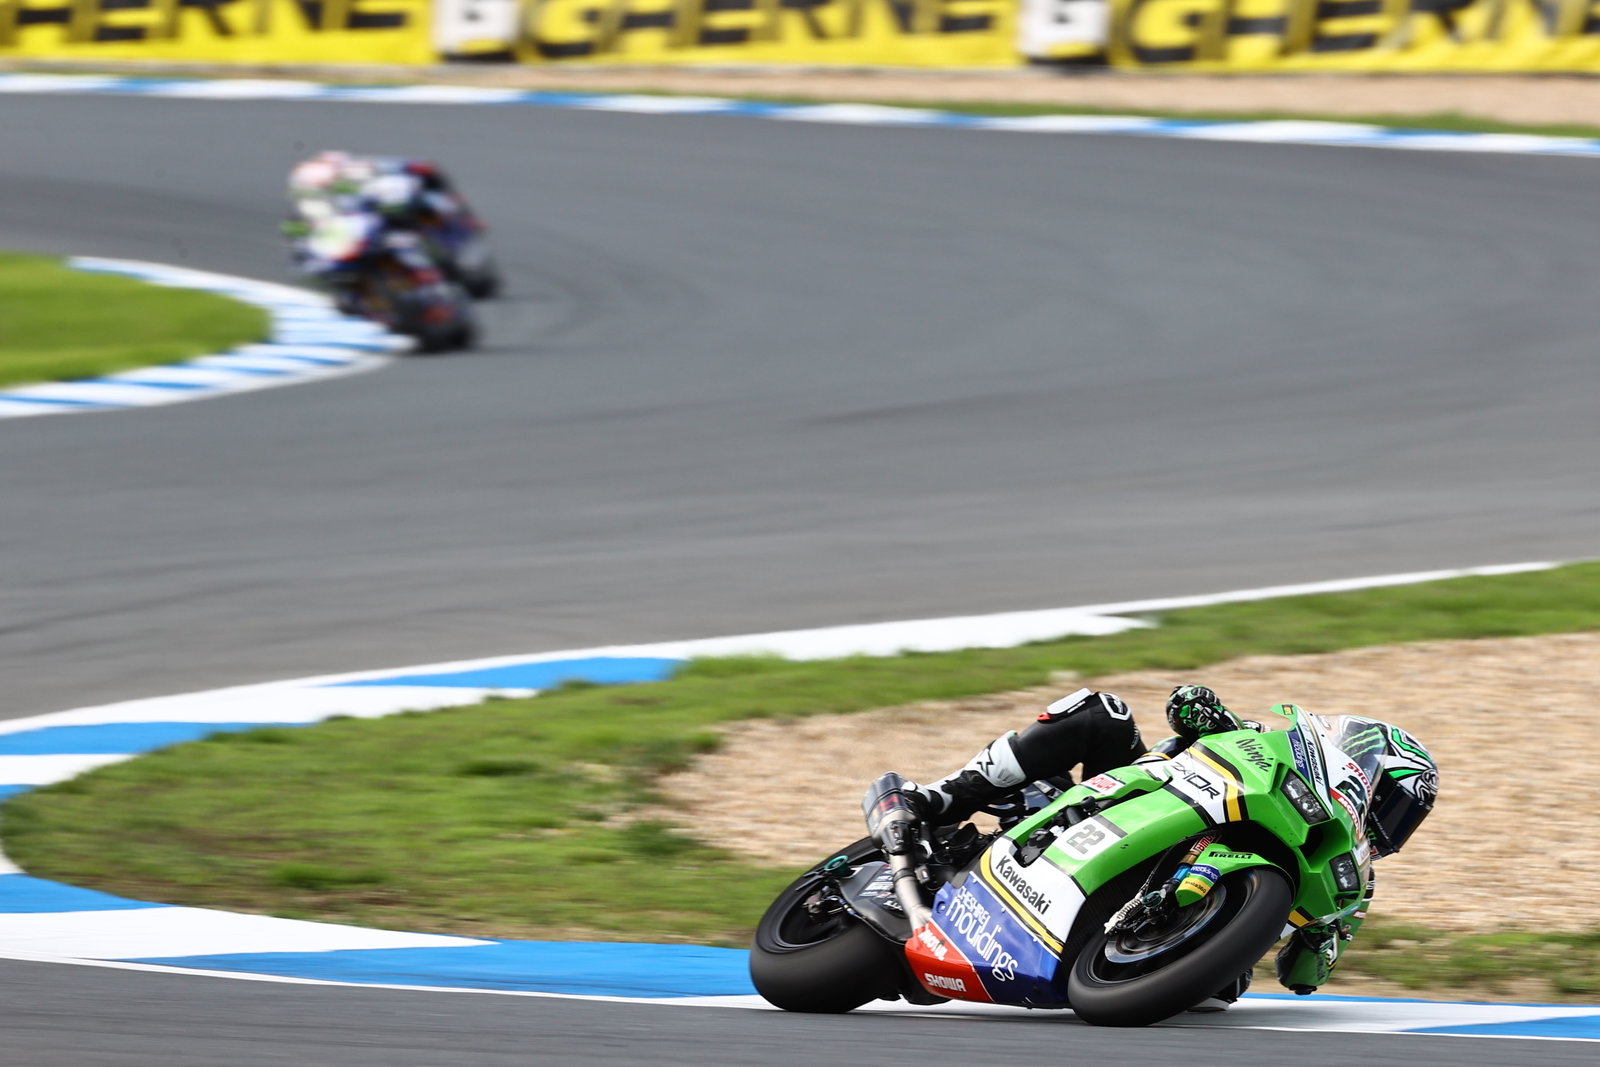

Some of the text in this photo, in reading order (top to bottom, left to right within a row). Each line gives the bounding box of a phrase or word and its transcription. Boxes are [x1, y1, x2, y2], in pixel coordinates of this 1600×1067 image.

[1235, 738, 1274, 772] Ninja
[1305, 738, 1324, 787] Kawasaki
[1065, 824, 1106, 855] 22
[1208, 851, 1254, 860] PIRELLI
[995, 854, 1052, 915] Kawasaki
[917, 929, 949, 961] MOTUL
[945, 897, 1018, 982] mouldings
[923, 973, 967, 992] SHOWA
